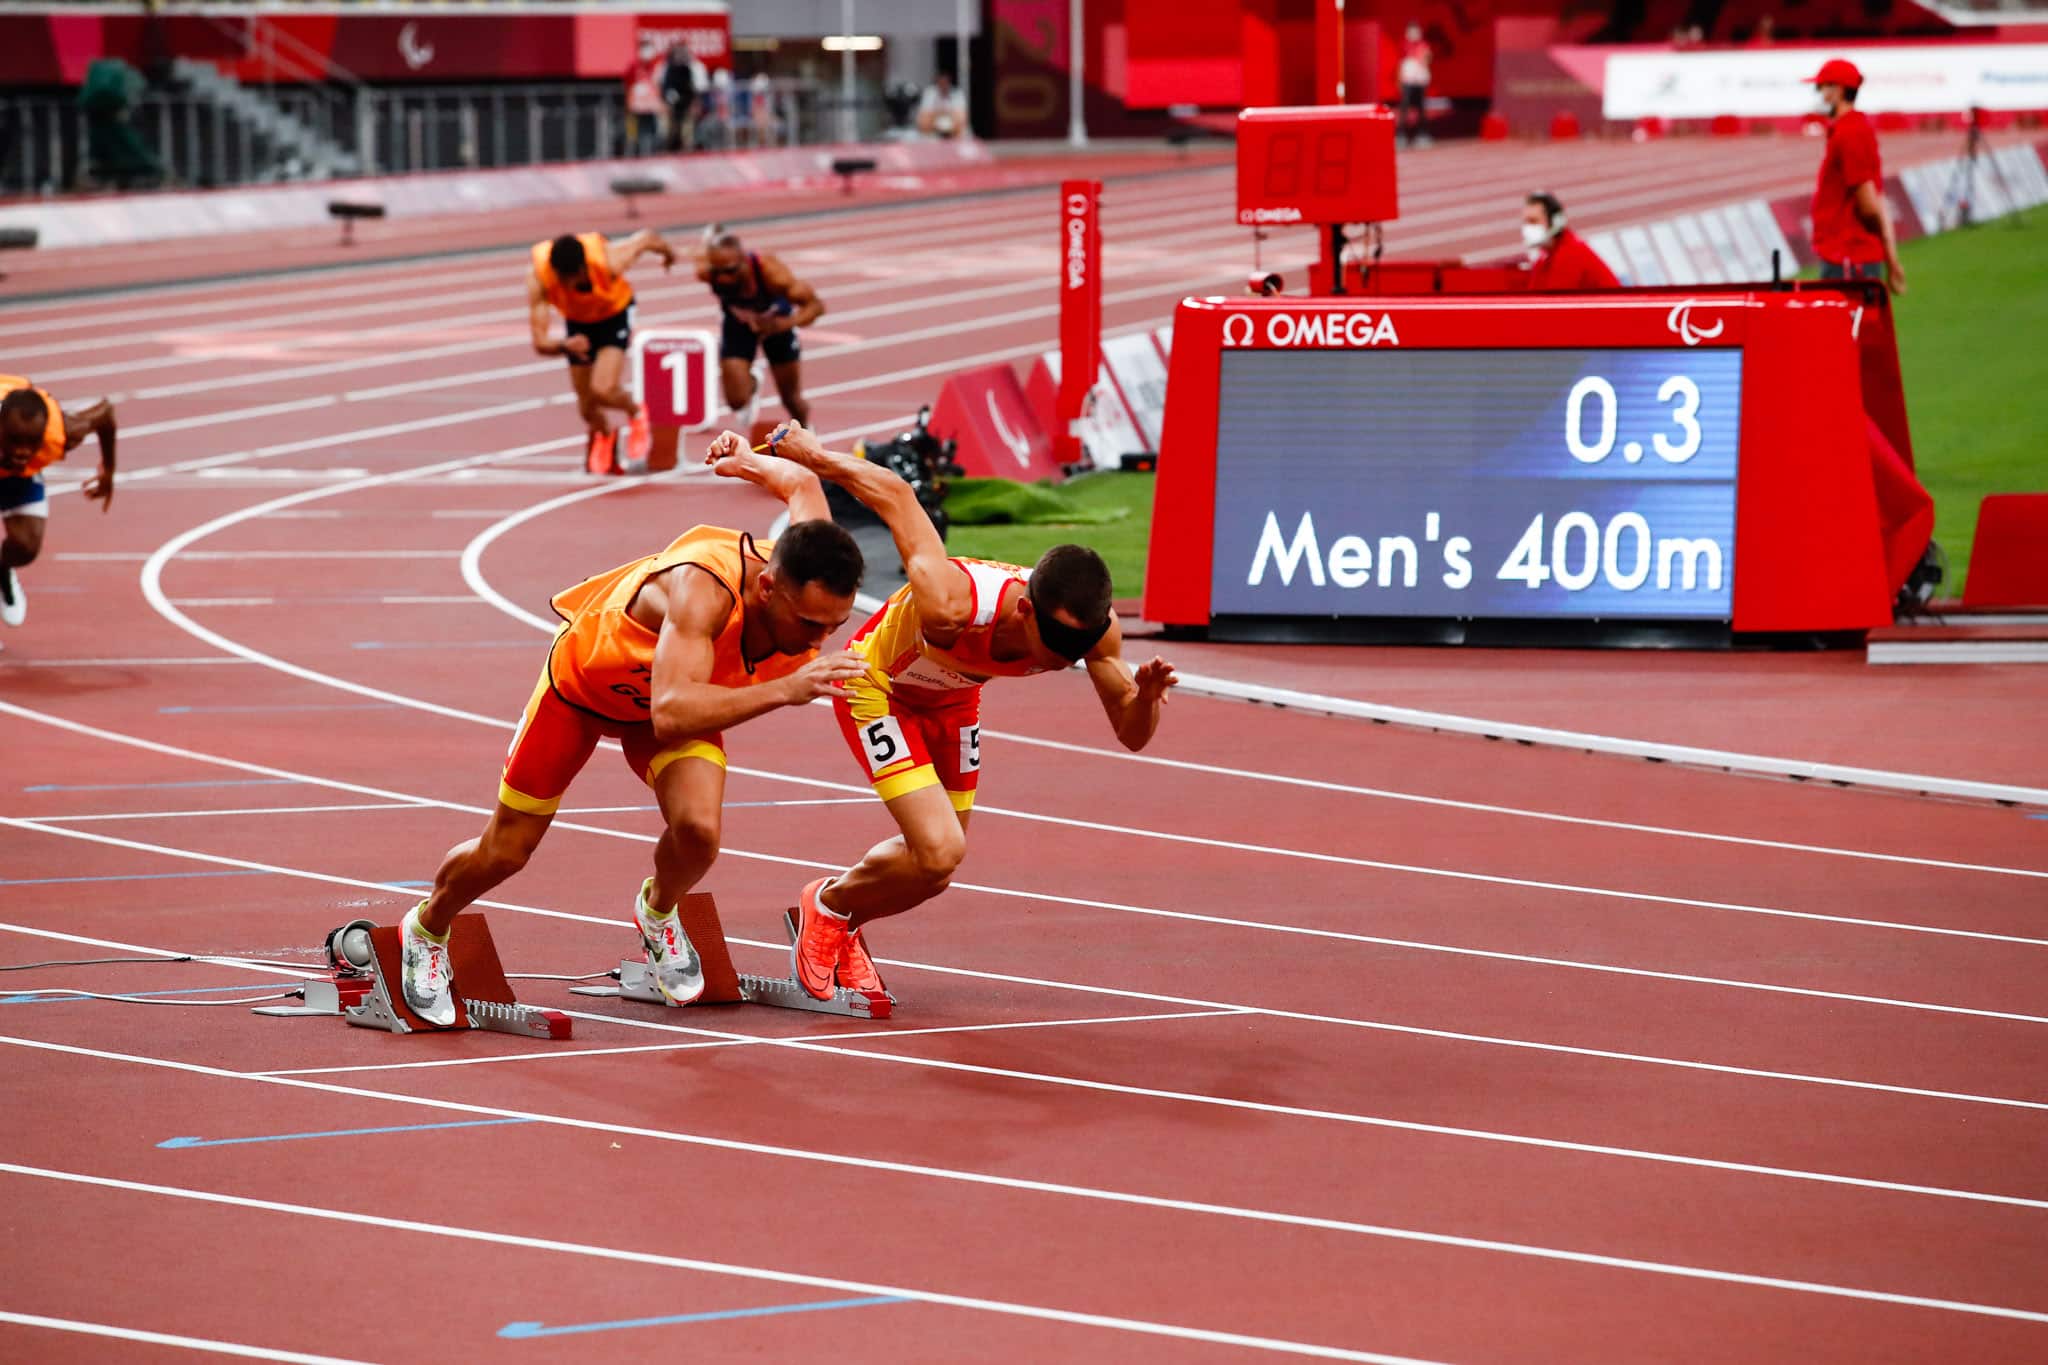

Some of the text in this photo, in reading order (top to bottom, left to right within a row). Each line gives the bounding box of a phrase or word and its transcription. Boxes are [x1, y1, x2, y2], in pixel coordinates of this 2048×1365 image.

[1069, 218, 1086, 289] OMEGA
[1267, 312, 1399, 347] OMEGA
[660, 351, 688, 416] 1
[1565, 375, 1702, 463] 0.3
[1248, 511, 1723, 590] Men's 400m
[867, 721, 896, 762] 5
